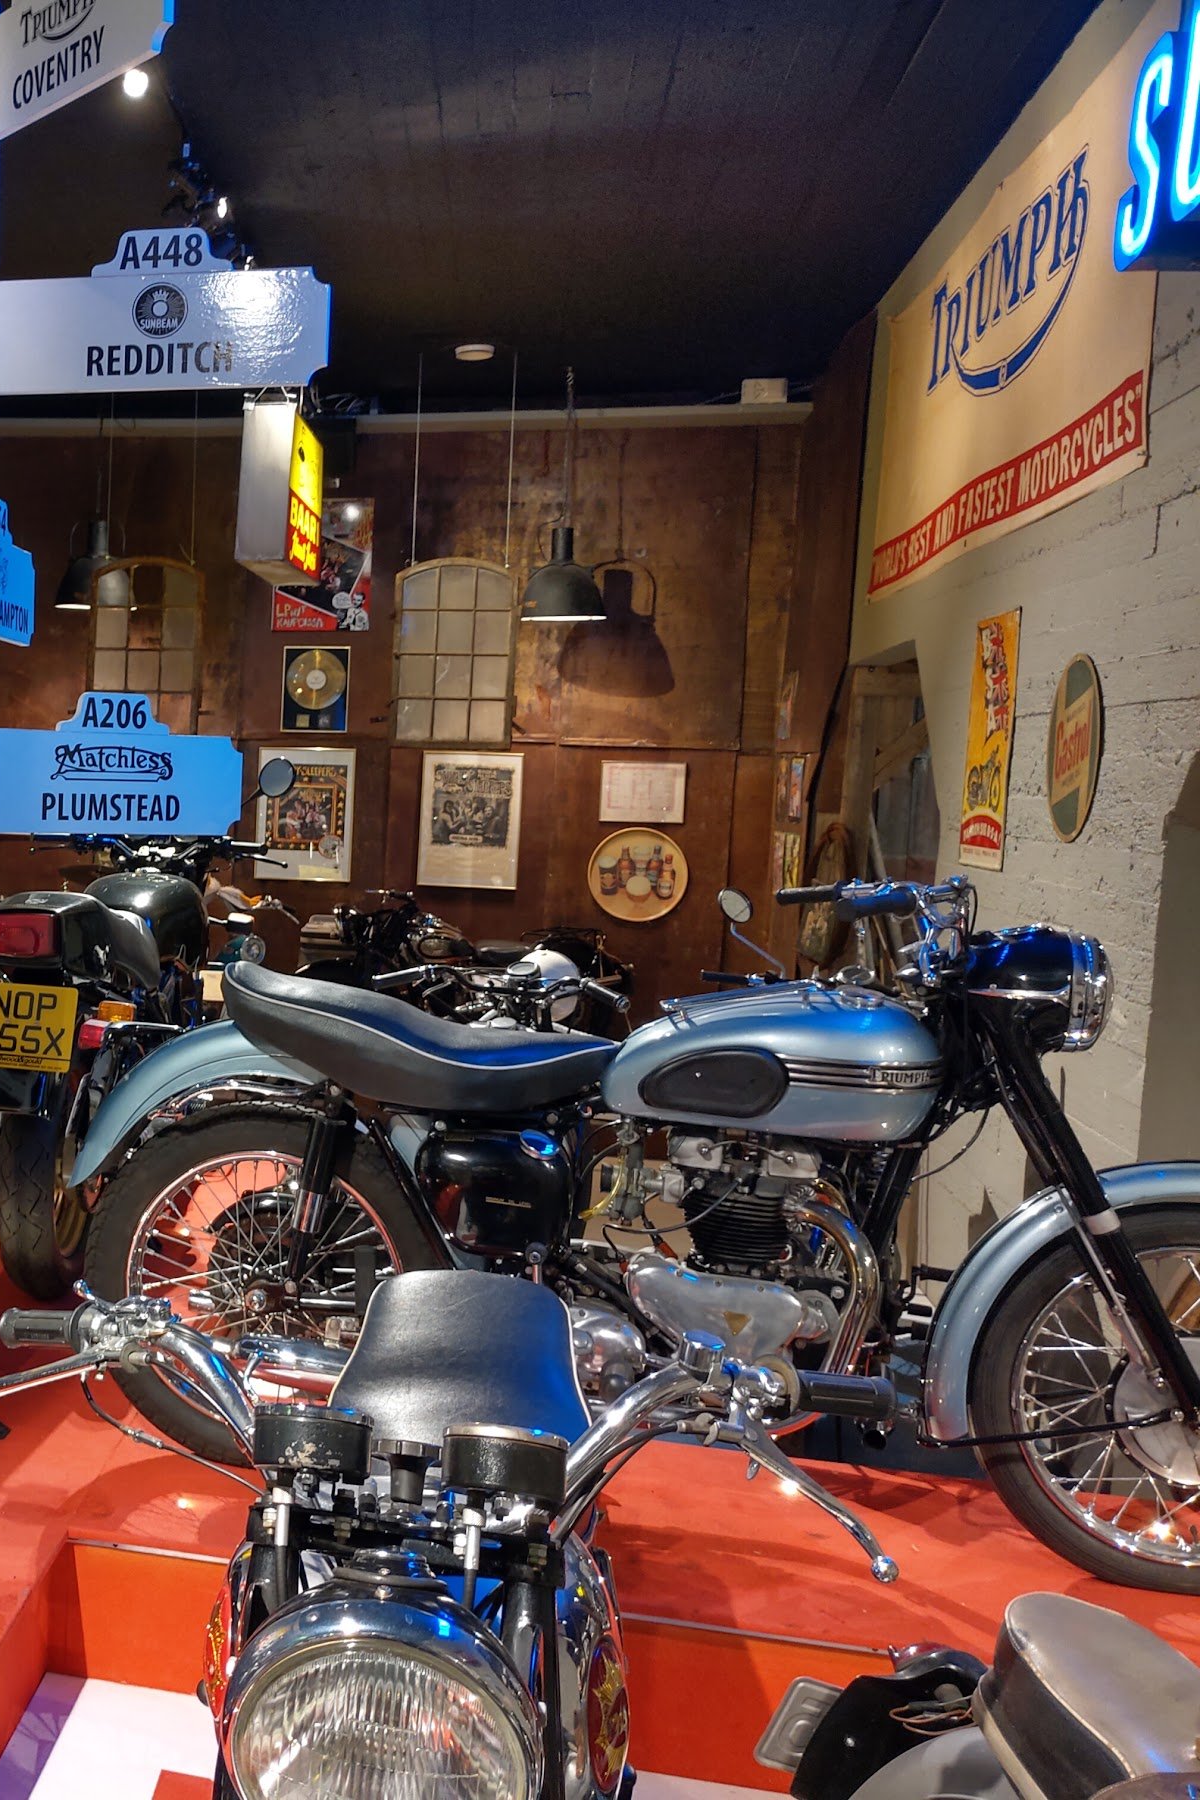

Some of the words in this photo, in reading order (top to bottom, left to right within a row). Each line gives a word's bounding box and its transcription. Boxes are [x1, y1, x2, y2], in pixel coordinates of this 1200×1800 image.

[20, 0, 96, 47] TRIUMP
[13, 25, 104, 109] COVENTRY
[119, 233, 203, 270] A448
[927, 143, 1090, 396] TRIUMPH
[139, 317, 178, 330] SUNBEAM
[86, 341, 233, 376] REDDITCH
[908, 521, 934, 568] BEST
[933, 506, 955, 551] AND
[956, 468, 1014, 535] FASTEST
[1016, 384, 1142, 507] MOTORCYCLES"
[290, 496, 319, 547] BAARI
[82, 697, 147, 729] A206
[52, 743, 174, 781] Matchless
[41, 792, 180, 822] PLUMSTEAD
[867, 1067, 931, 1083] TRIUMPH
